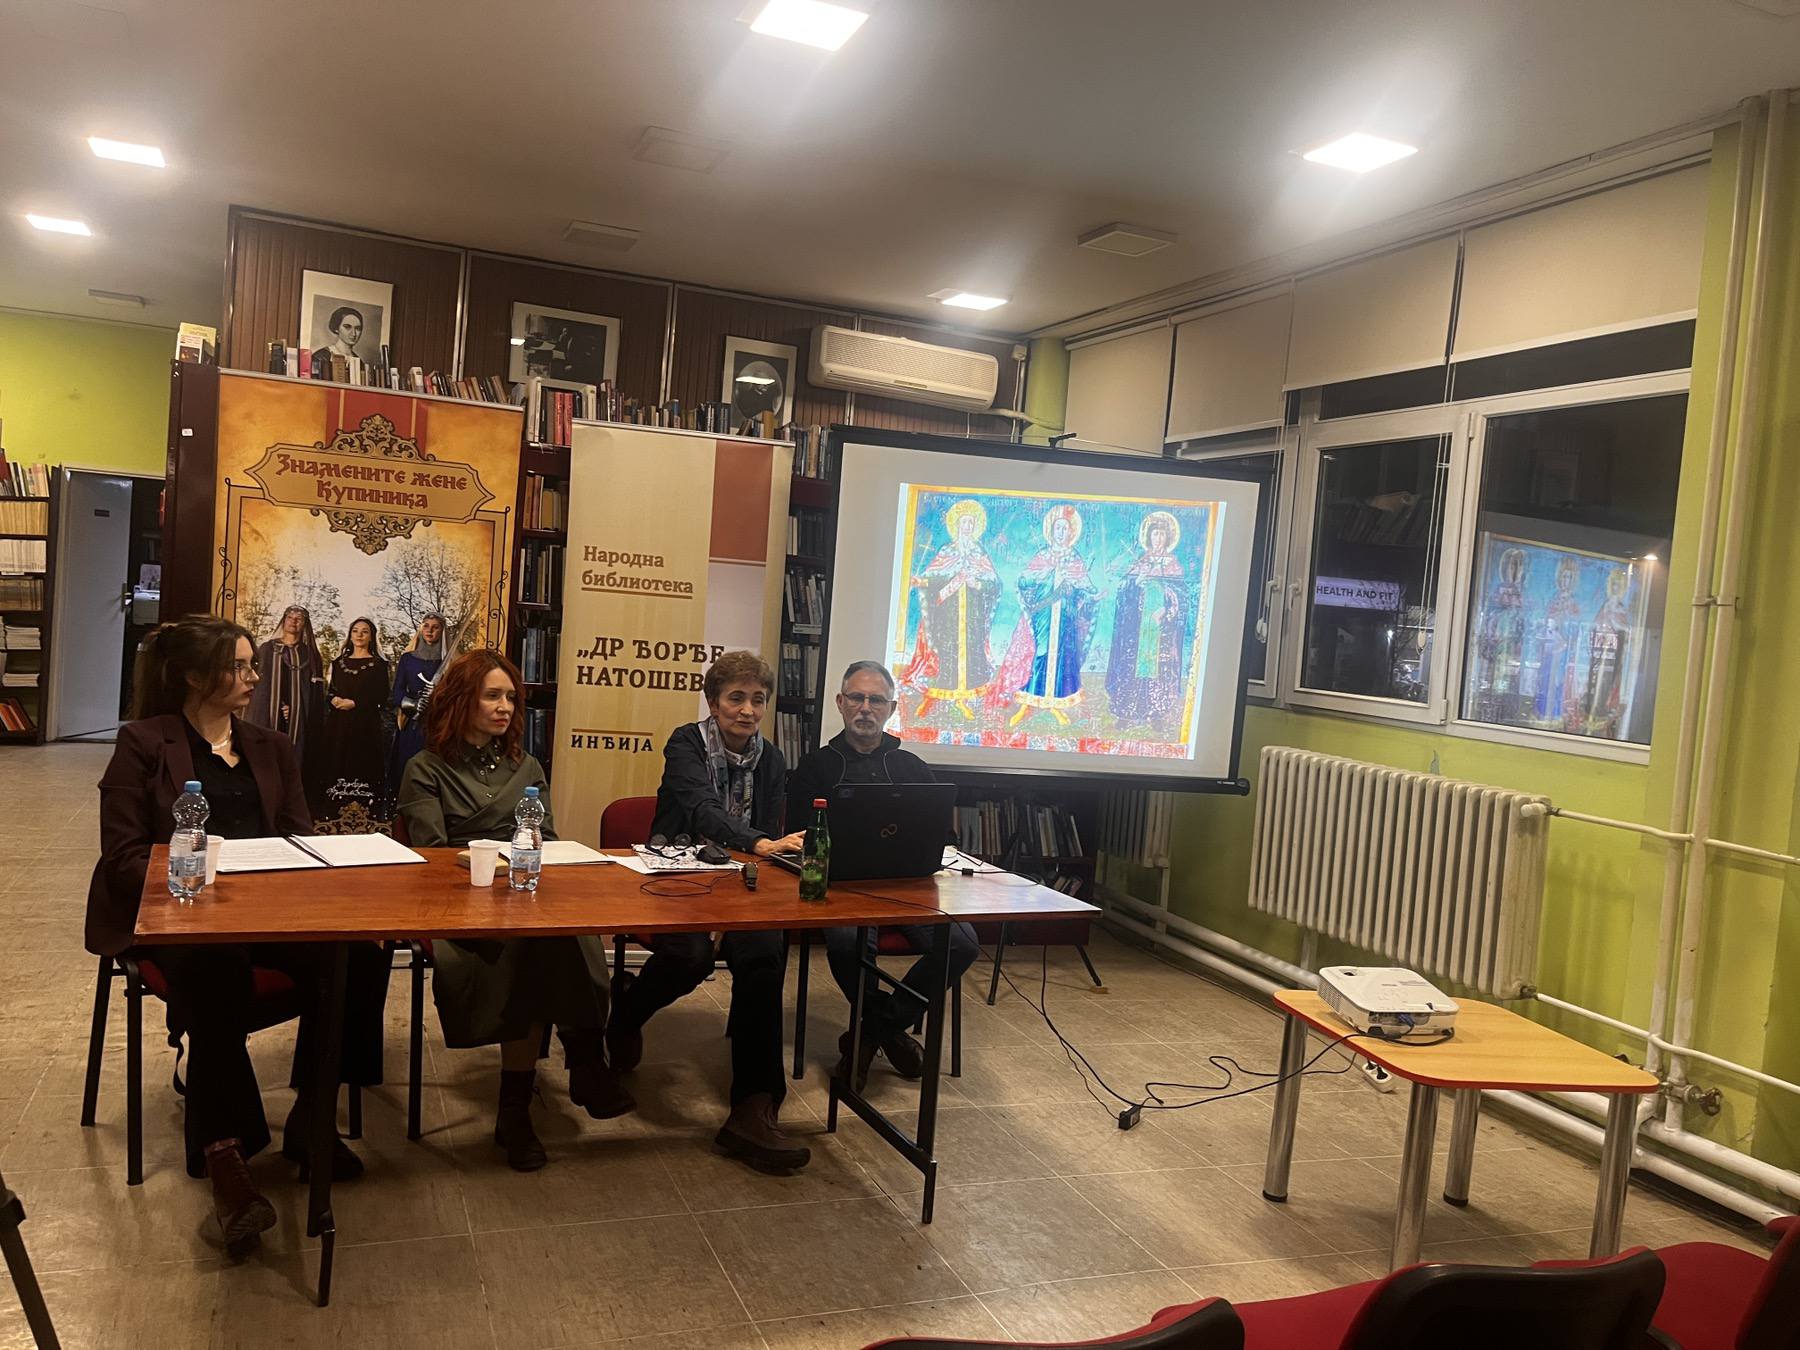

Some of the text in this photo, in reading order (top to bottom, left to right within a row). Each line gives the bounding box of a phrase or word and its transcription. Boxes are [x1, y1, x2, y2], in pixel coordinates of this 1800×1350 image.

[583, 545, 664, 567] Народна
[581, 570, 693, 594] библиотека
[1316, 586, 1353, 597] HEALTH
[1356, 590, 1377, 599] AND
[576, 665, 705, 692] НАТОШЕВ
[571, 734, 653, 754] ИНЂИЈА
